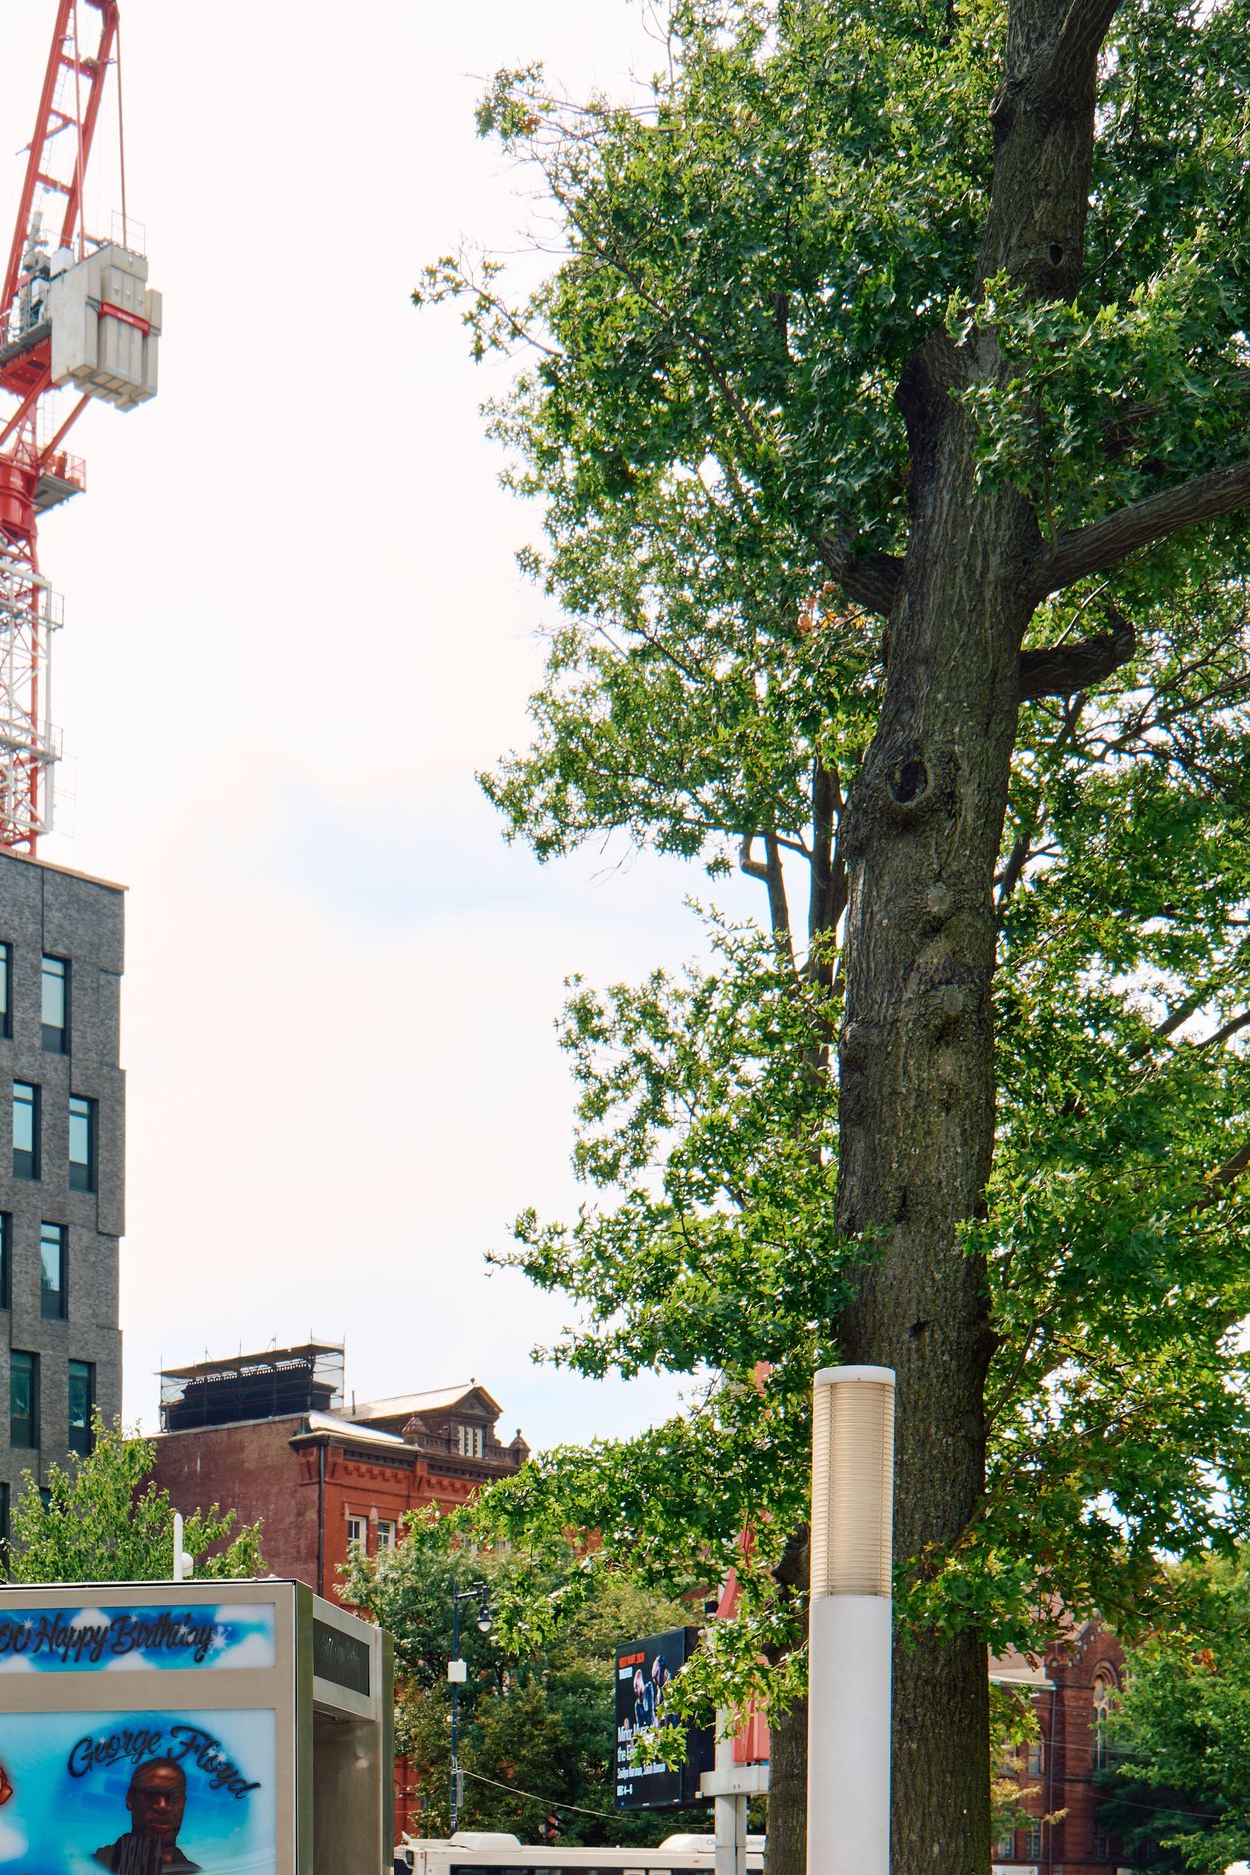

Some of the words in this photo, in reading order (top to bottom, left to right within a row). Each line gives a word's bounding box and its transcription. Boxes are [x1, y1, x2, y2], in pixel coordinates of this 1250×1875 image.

[32, 1613, 109, 1663] Happy
[111, 1612, 215, 1663] Birthday
[68, 1729, 163, 1778] George
[168, 1726, 261, 1799] Floyd
